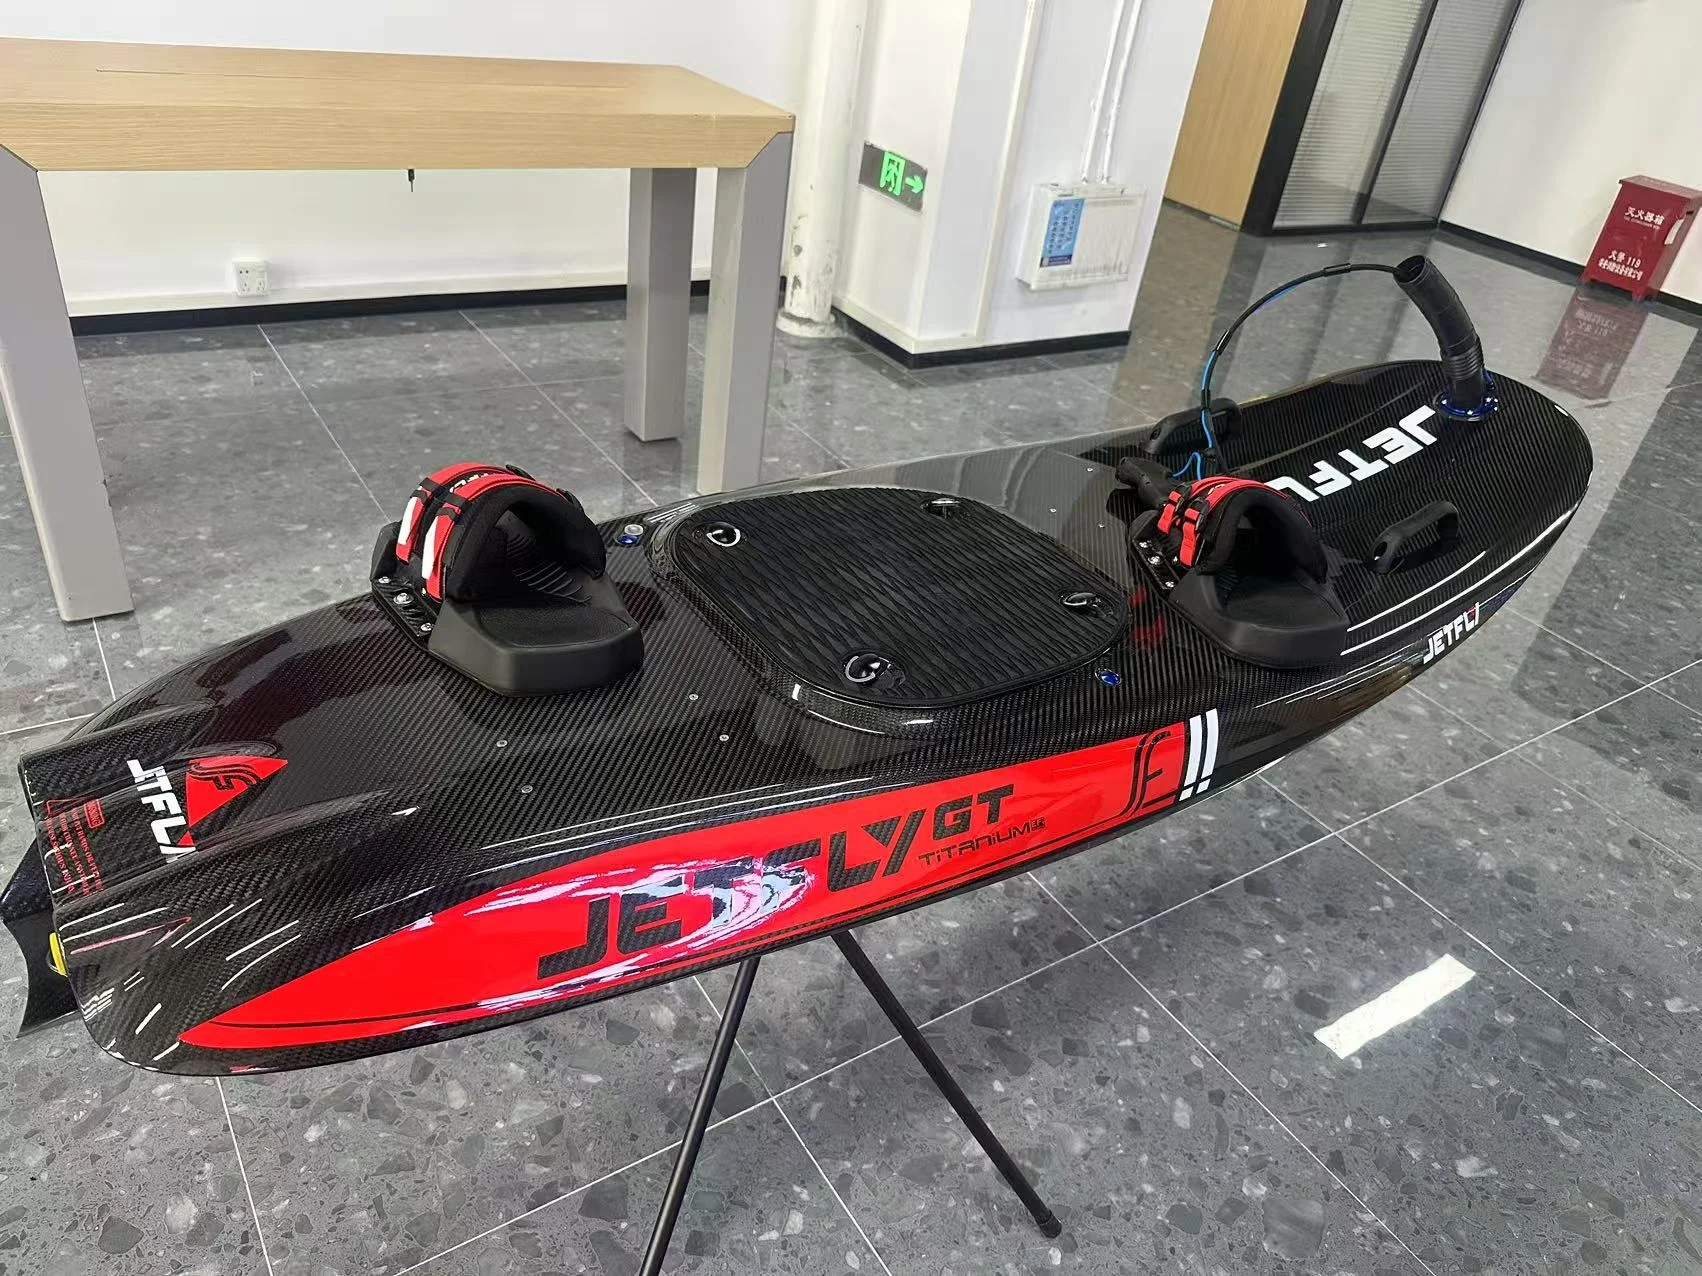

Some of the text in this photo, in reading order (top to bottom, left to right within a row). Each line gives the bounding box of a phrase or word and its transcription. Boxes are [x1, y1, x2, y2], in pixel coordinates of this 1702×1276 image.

[1624, 206, 1665, 226] 灭火器箱
[1626, 256, 1641, 269] 119
[1264, 405, 1438, 502] JETFL
[538, 783, 1015, 980] JETFLY GT
